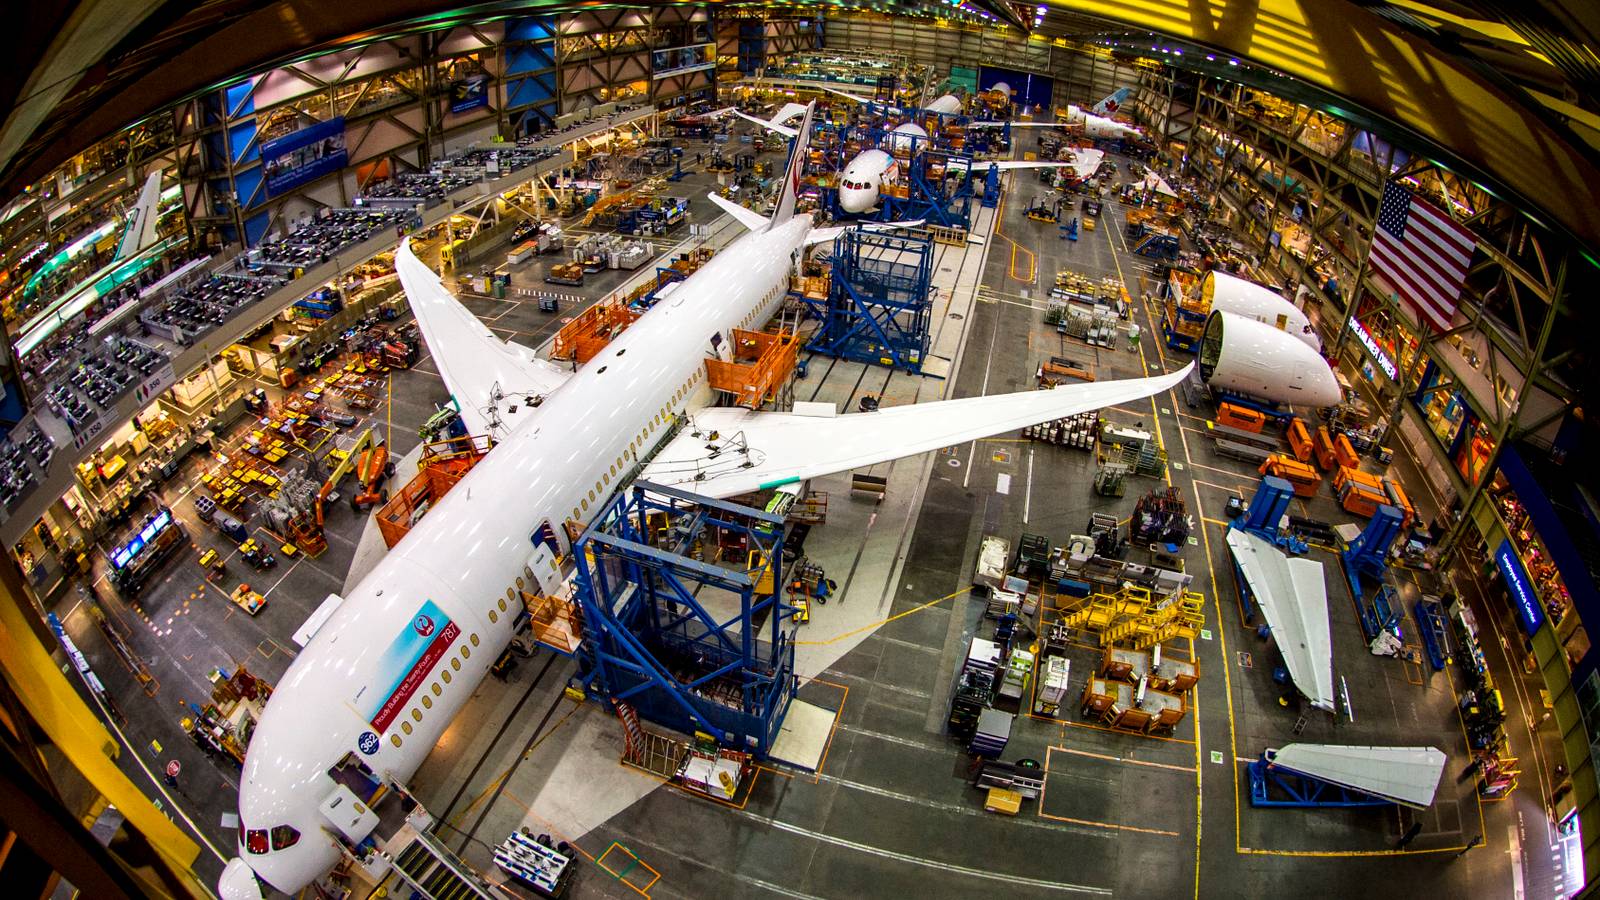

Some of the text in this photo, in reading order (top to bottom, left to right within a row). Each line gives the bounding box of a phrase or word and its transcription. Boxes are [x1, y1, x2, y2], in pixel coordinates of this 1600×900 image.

[1377, 351, 1397, 381] DINER
[148, 378, 161, 390] 350
[89, 422, 102, 436] 350
[1515, 579, 1527, 603] Service
[1525, 601, 1536, 623] Center
[375, 706, 391, 726] Proudly
[389, 689, 404, 708] Building
[441, 623, 457, 643] 787
[360, 733, 378, 753] 362
